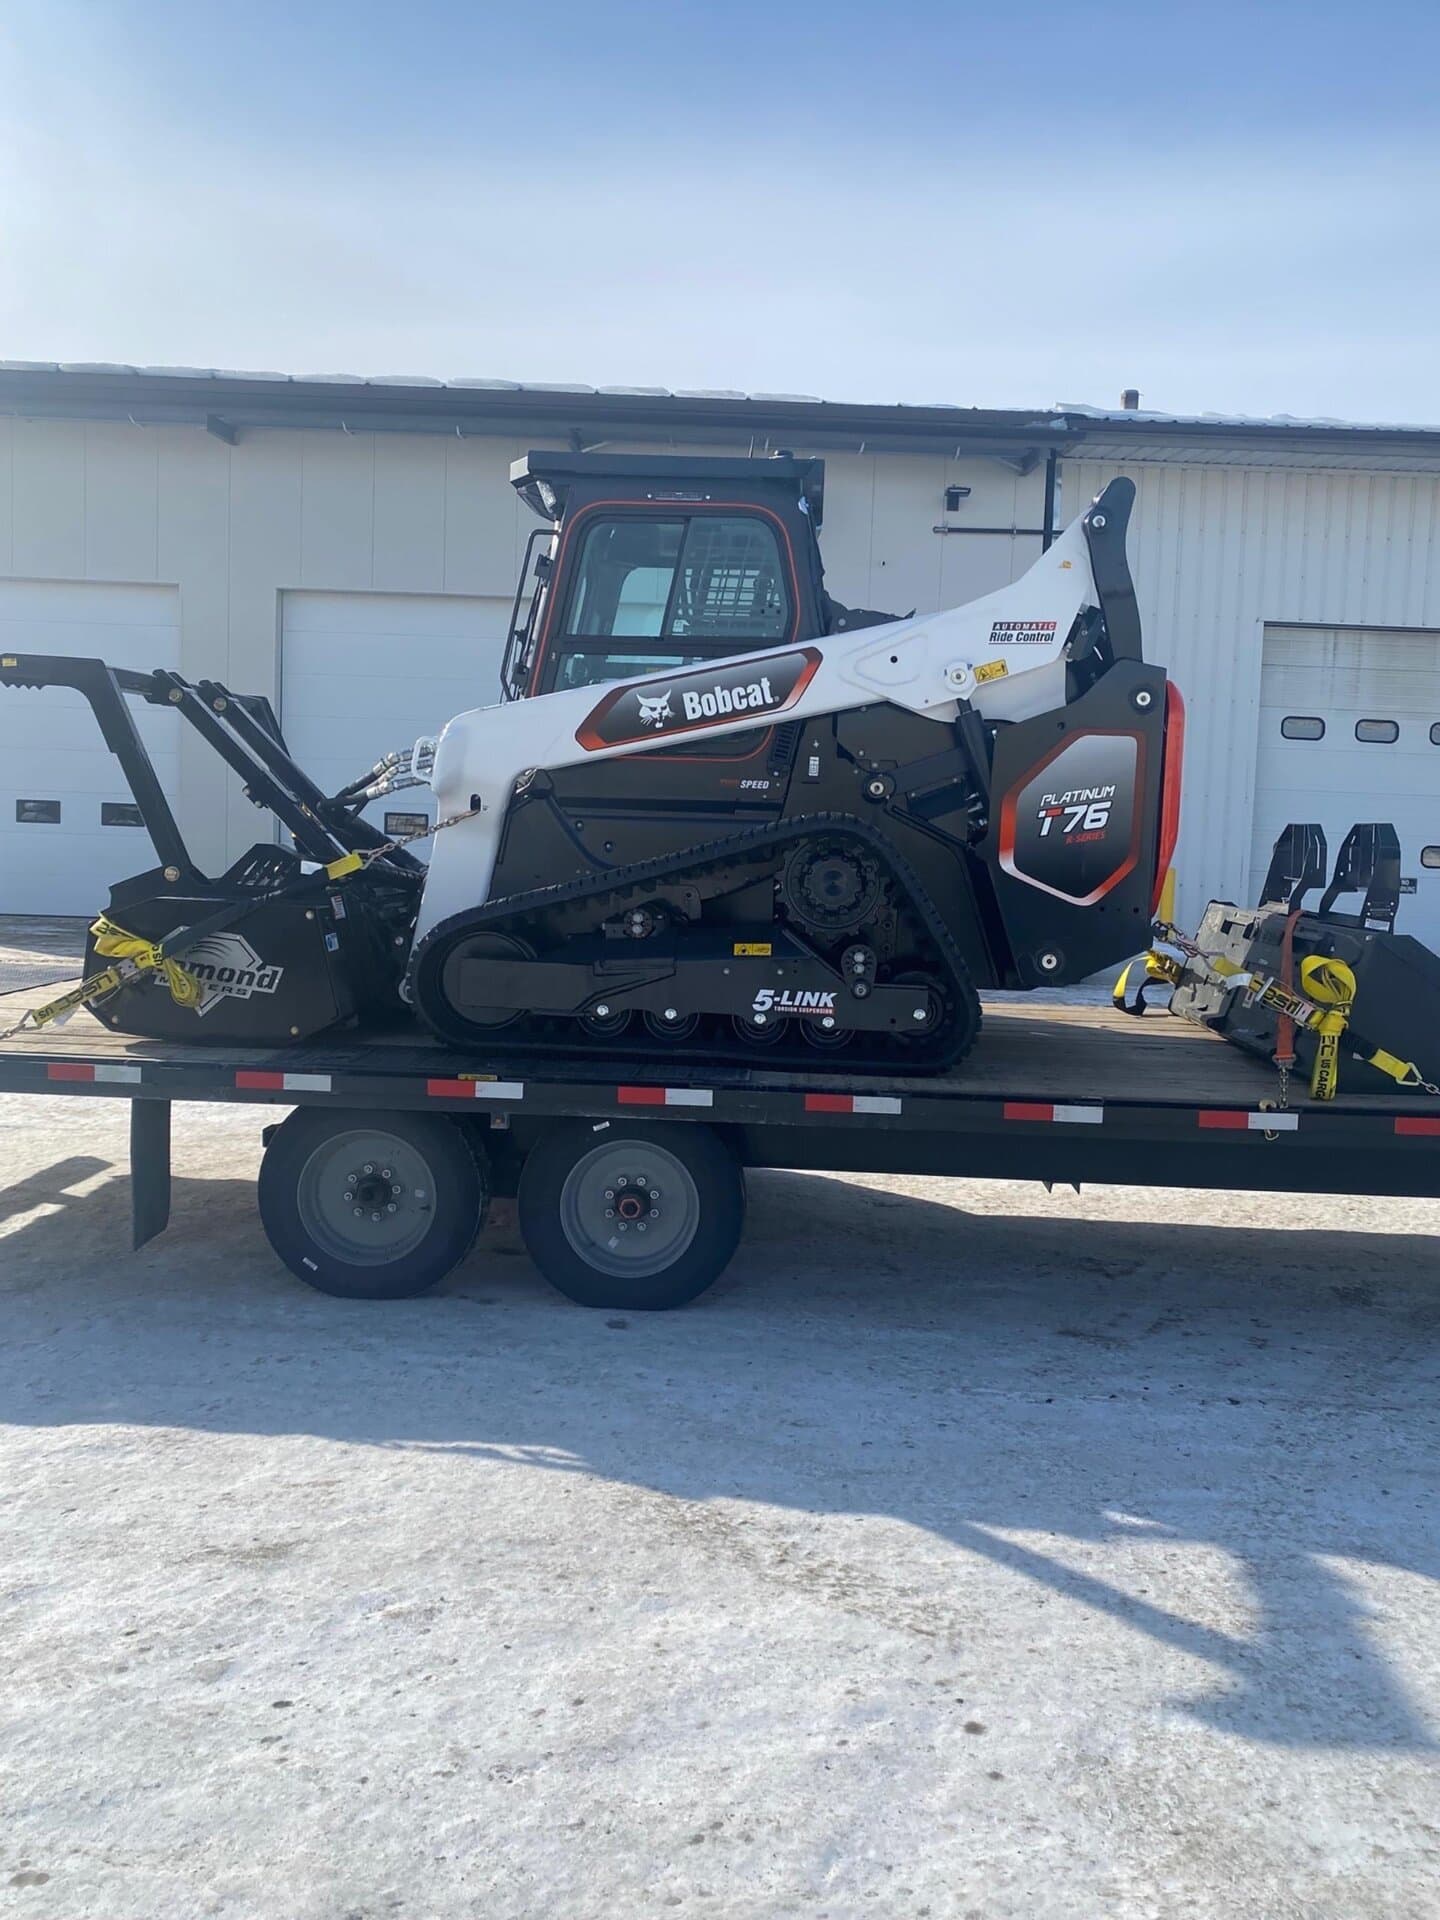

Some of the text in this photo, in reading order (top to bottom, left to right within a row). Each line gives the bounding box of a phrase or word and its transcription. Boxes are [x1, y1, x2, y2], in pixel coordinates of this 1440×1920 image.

[989, 631, 1056, 642] Ride Control
[682, 677, 774, 720] Bobcat
[740, 780, 770, 790] SPEED
[1040, 785, 1116, 807] PLATINUM
[1038, 801, 1112, 837] T76
[183, 960, 280, 990] mond
[752, 989, 838, 1012] 5-LINK
